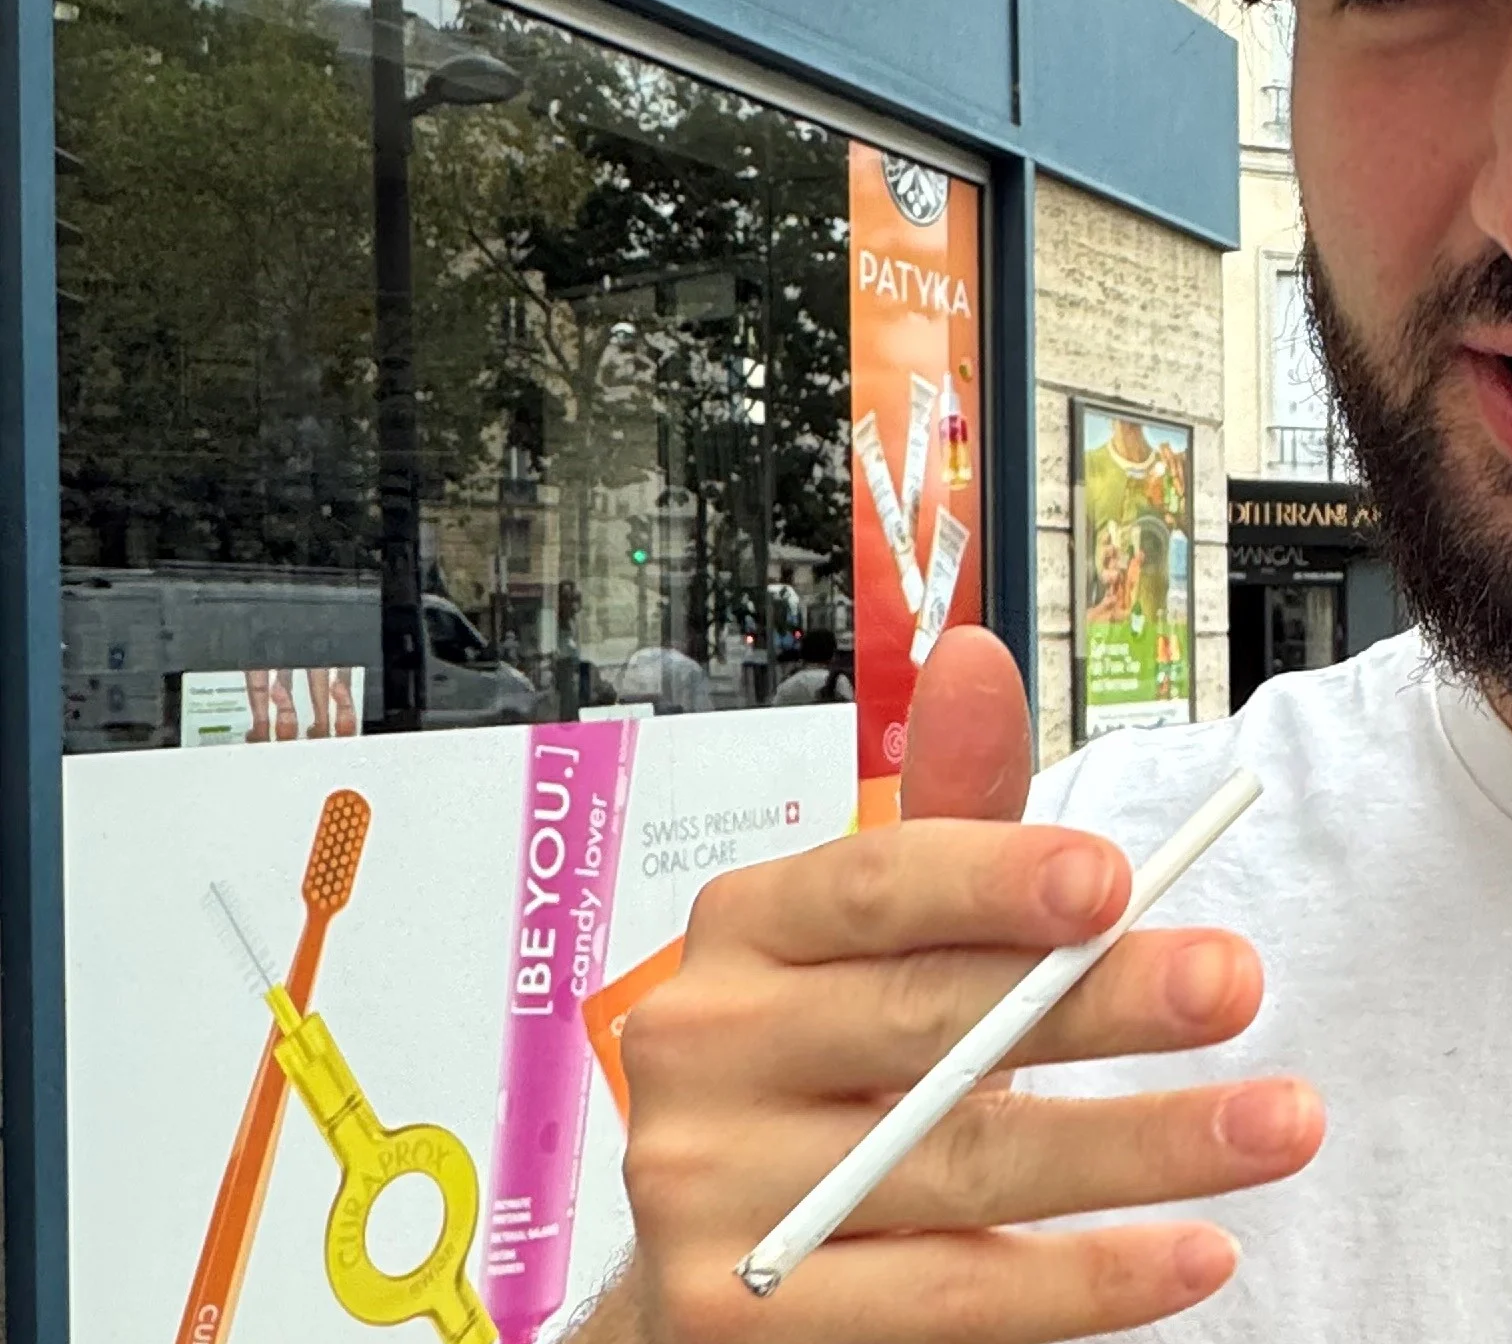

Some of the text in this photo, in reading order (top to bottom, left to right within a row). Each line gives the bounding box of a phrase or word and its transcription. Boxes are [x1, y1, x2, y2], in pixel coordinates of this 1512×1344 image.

[859, 249, 971, 319] PATYKA
[642, 806, 780, 847] SWISS PREMIUM
[642, 839, 737, 878] ORAL CARE
[569, 792, 607, 997] candy lover
[339, 1137, 450, 1270] CURAPROX
